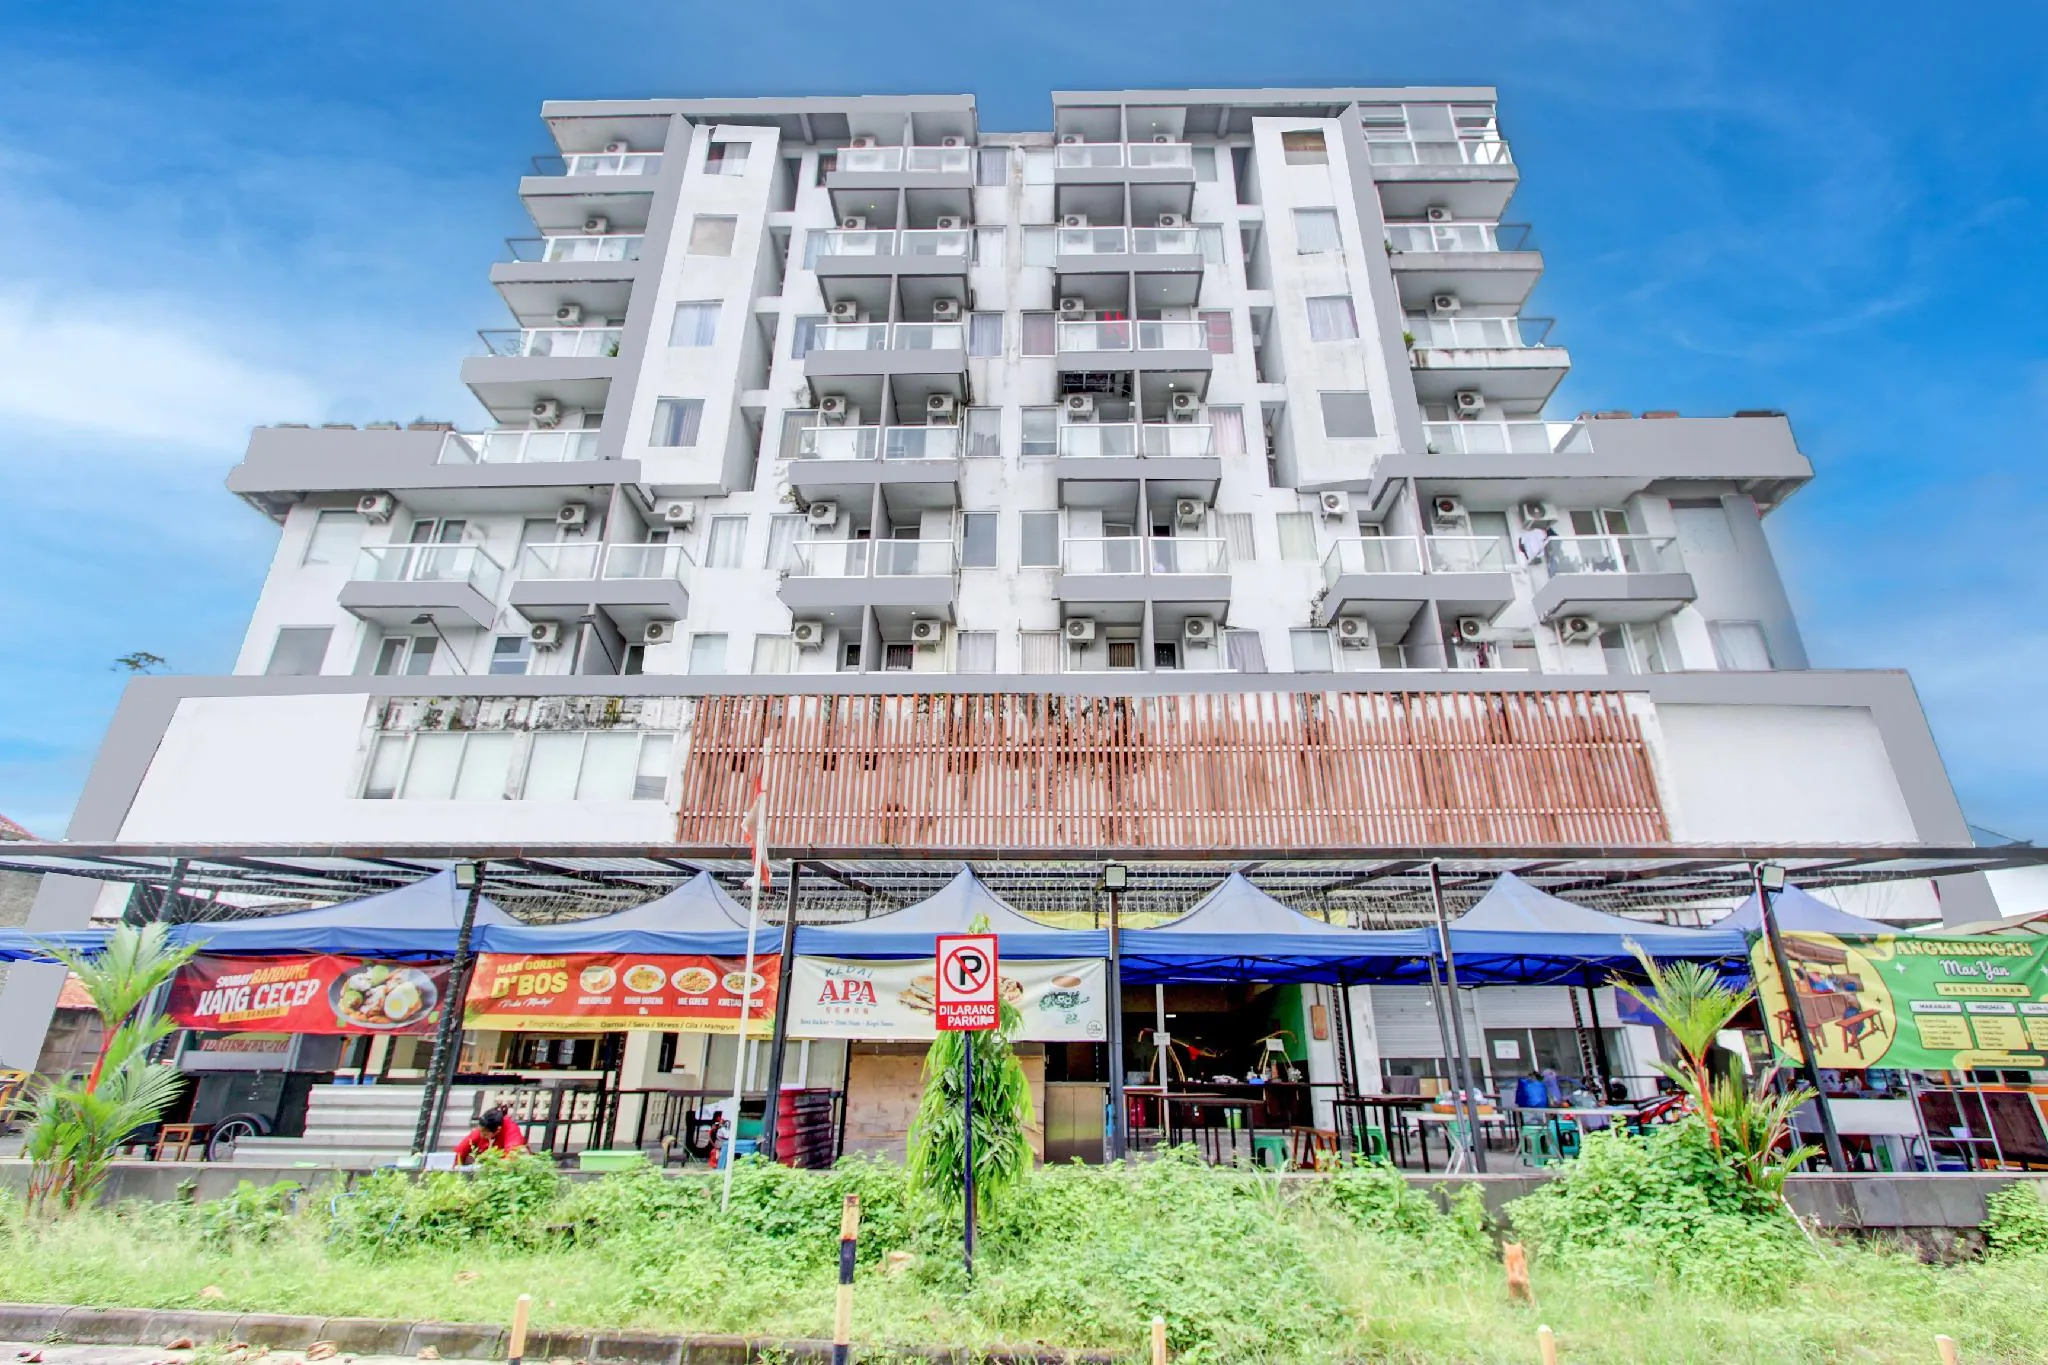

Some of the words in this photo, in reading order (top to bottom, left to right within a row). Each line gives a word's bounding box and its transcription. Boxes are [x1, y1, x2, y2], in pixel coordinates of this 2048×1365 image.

[1896, 941, 2033, 956] ANGKRINGAN
[250, 964, 309, 984] BANDUNG
[497, 963, 523, 974] NASI
[524, 959, 567, 971] GORENG
[1939, 959, 1979, 976] Mas
[1976, 960, 2011, 981] Yan
[491, 971, 568, 997] D'BOS
[817, 979, 878, 1006] APA
[194, 986, 251, 1017] KANG
[254, 979, 320, 1008] CECEP
[939, 1004, 995, 1016] DILARANG
